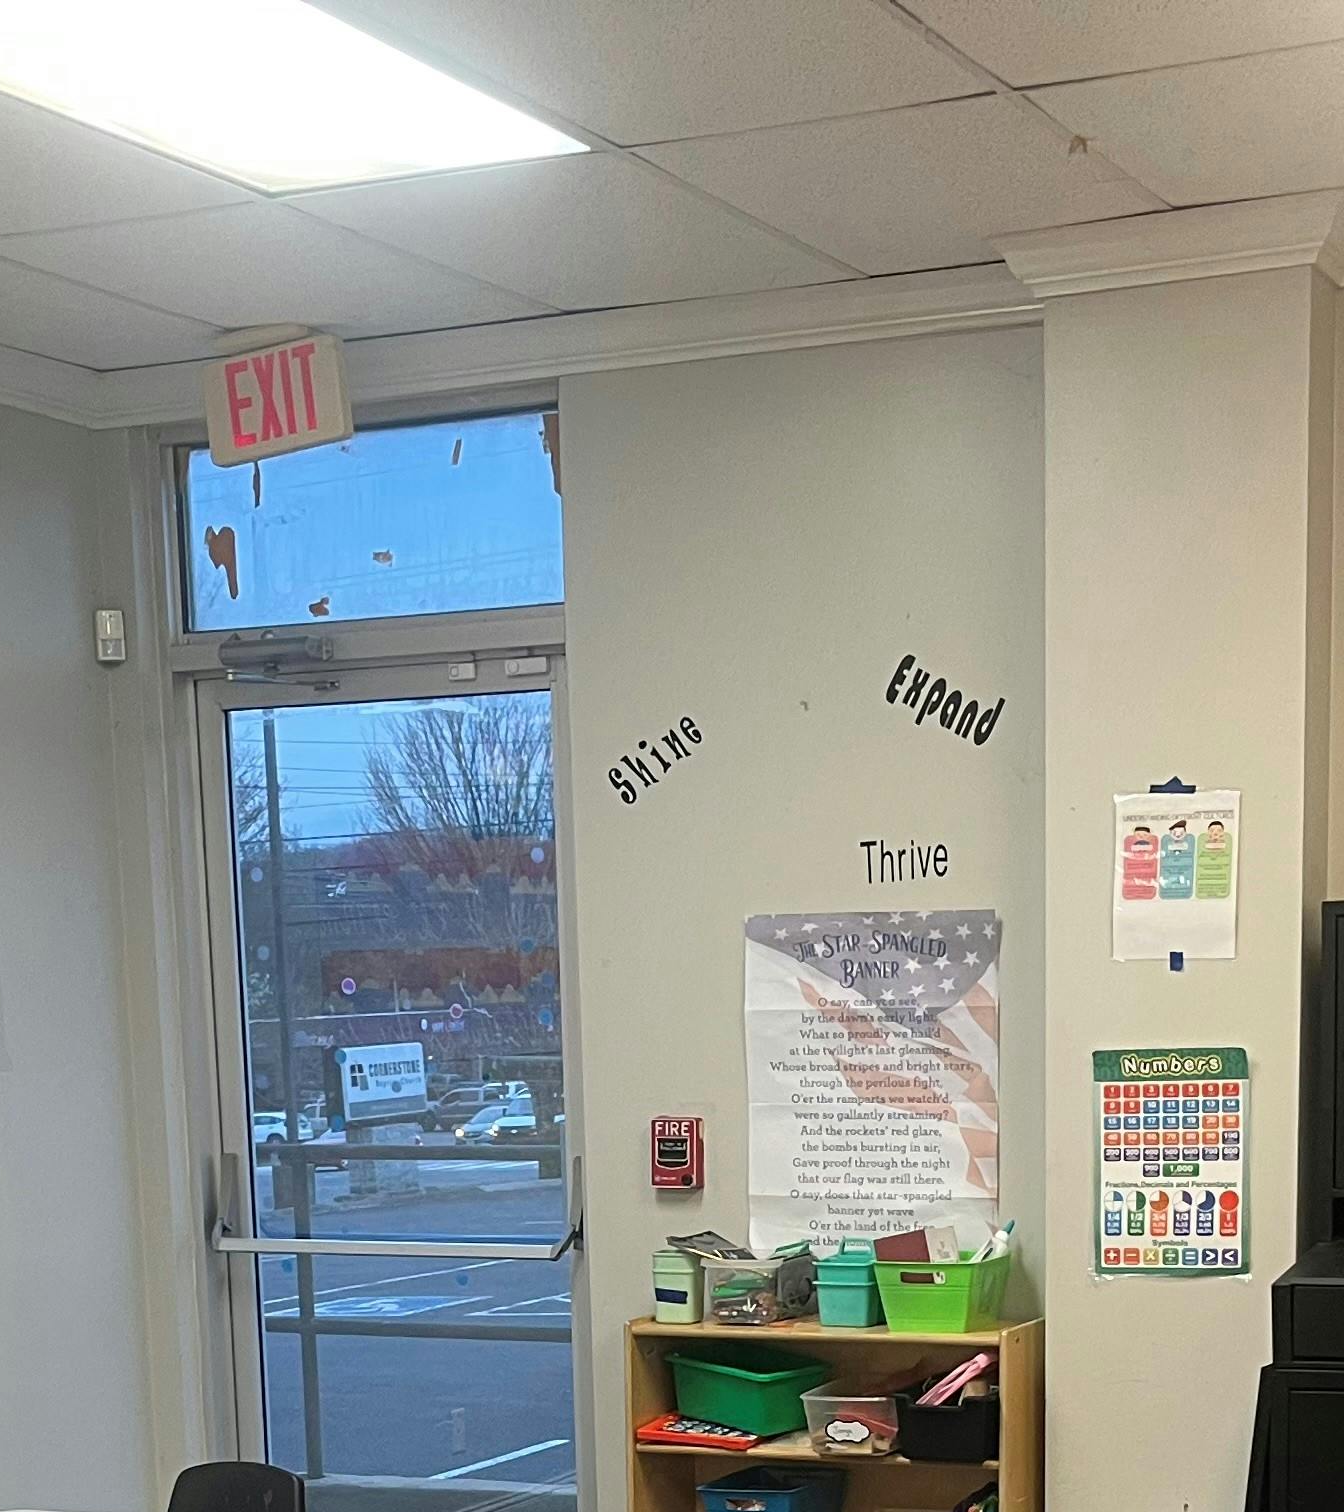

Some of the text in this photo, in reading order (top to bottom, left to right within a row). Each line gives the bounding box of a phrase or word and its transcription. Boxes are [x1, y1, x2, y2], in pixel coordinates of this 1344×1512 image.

[224, 342, 318, 448] EXIT
[885, 653, 1006, 746] Expand
[608, 715, 703, 804] Shine
[859, 839, 949, 884] Thrive
[818, 998, 828, 1007] O
[853, 998, 873, 1007] can
[801, 1013, 814, 1025] by
[817, 1012, 834, 1023] the
[877, 1012, 906, 1025] early
[799, 1029, 830, 1040] What
[832, 1032, 844, 1040] so
[847, 1029, 890, 1042] proudly
[893, 1031, 908, 1040] we
[802, 1045, 820, 1055] the
[875, 1044, 895, 1055] last
[770, 1061, 807, 1072] Whose
[809, 1060, 840, 1072] broad
[843, 1062, 880, 1074] stripes
[883, 1061, 903, 1072] and
[906, 1061, 941, 1074] bright
[1123, 1055, 1220, 1075] Numbers
[799, 1077, 843, 1090] through
[845, 1076, 863, 1088] the
[865, 1076, 911, 1090] perilous
[817, 1093, 834, 1104] the
[836, 1095, 886, 1106] ramparts
[888, 1096, 904, 1104] we
[794, 1111, 820, 1120] were
[822, 1111, 834, 1120] so
[837, 1109, 885, 1122] gallantly
[655, 1121, 691, 1136] FIRE
[800, 1125, 823, 1136] And
[825, 1125, 842, 1136] the
[891, 1125, 909, 1136] red
[801, 1142, 819, 1152] the
[822, 1141, 857, 1152] bombs
[860, 1141, 907, 1154] bursting
[909, 1141, 921, 1152] in
[792, 1156, 950, 1171] Gave proof through the night
[798, 1173, 820, 1184] that
[822, 1175, 841, 1184] our
[843, 1173, 864, 1186] flag
[867, 1176, 888, 1184] was
[890, 1173, 911, 1185] still
[790, 1189, 800, 1199] O
[825, 1189, 850, 1200] does
[852, 1189, 874, 1200] that
[827, 1204, 915, 1218] banner yet wave
[834, 1220, 851, 1231] the
[854, 1219, 877, 1231] land
[879, 1219, 891, 1231] of
[893, 1219, 911, 1232] the
